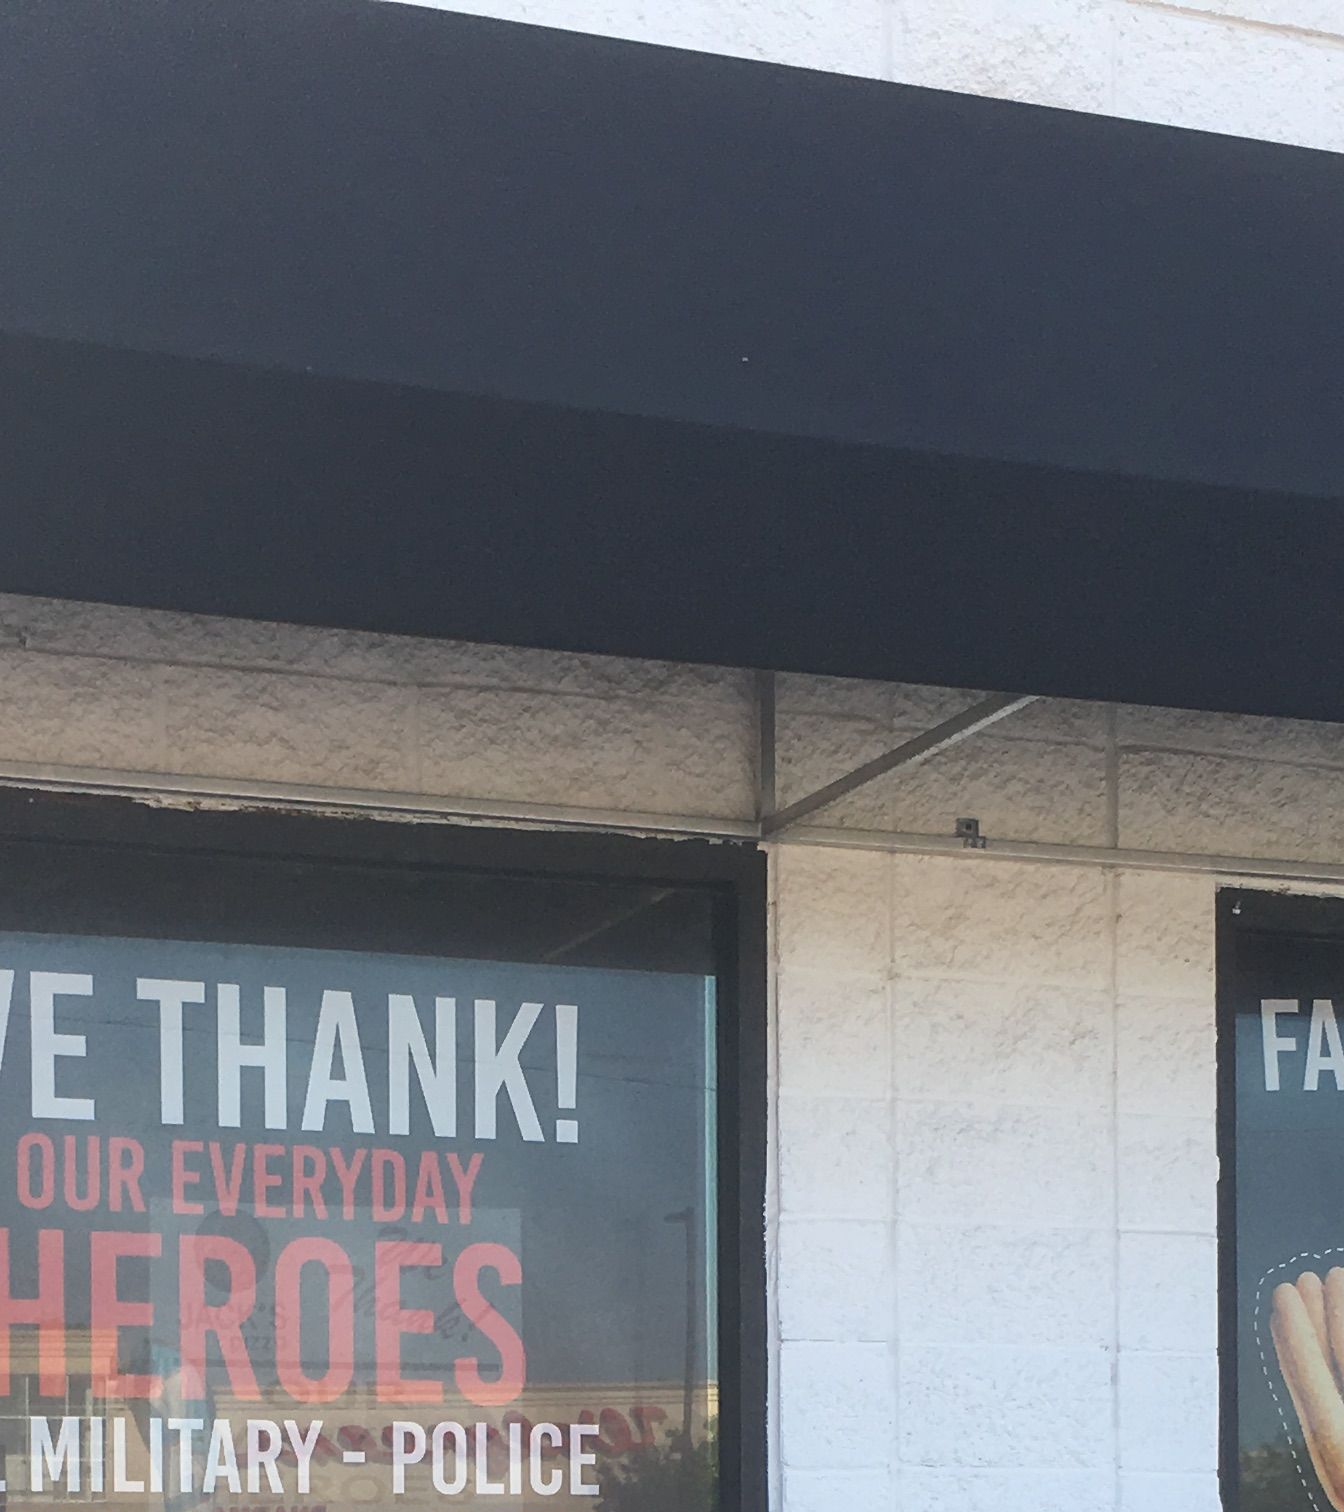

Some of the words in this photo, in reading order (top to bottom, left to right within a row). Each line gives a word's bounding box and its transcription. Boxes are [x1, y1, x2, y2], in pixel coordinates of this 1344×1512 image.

[136, 977, 580, 1145] THANK!
[17, 1132, 149, 1214] OUR
[172, 1140, 485, 1226] EVERYDAY
[29, 1414, 326, 1495] MILITARY
[392, 1420, 601, 1497] POLICE
